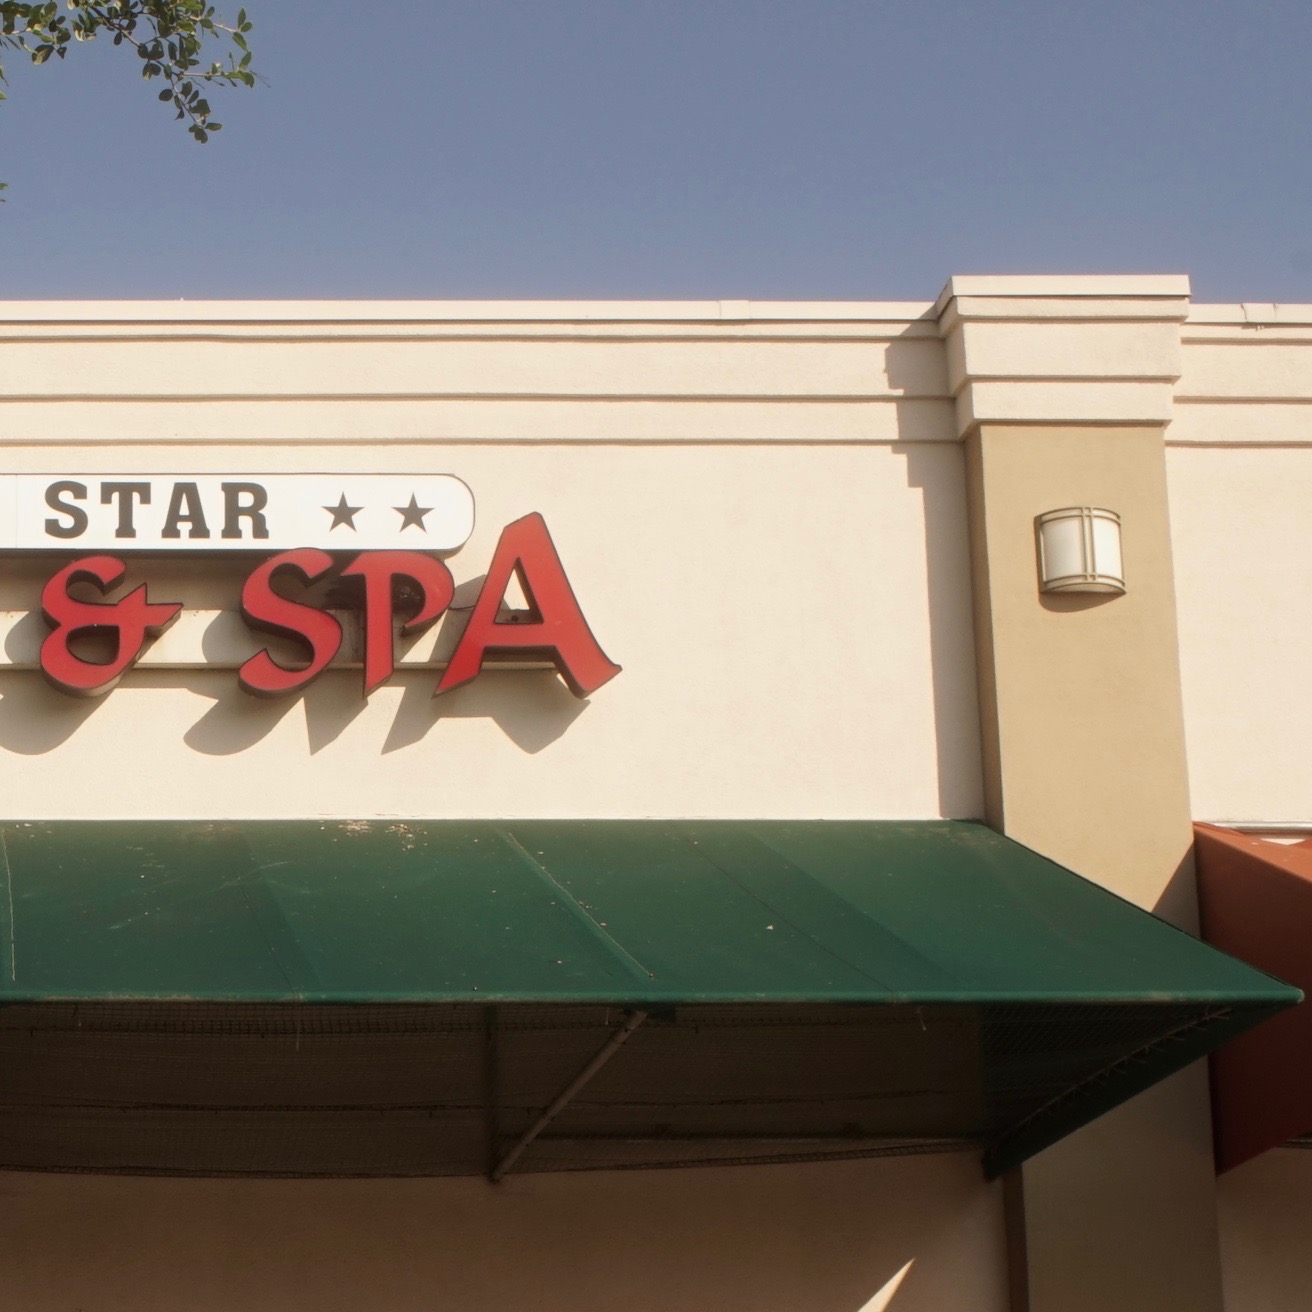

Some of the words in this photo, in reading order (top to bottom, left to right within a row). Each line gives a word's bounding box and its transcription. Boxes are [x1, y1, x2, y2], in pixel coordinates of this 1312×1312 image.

[42, 480, 271, 540] STAR
[41, 556, 184, 699] &
[237, 510, 624, 699] SPA
